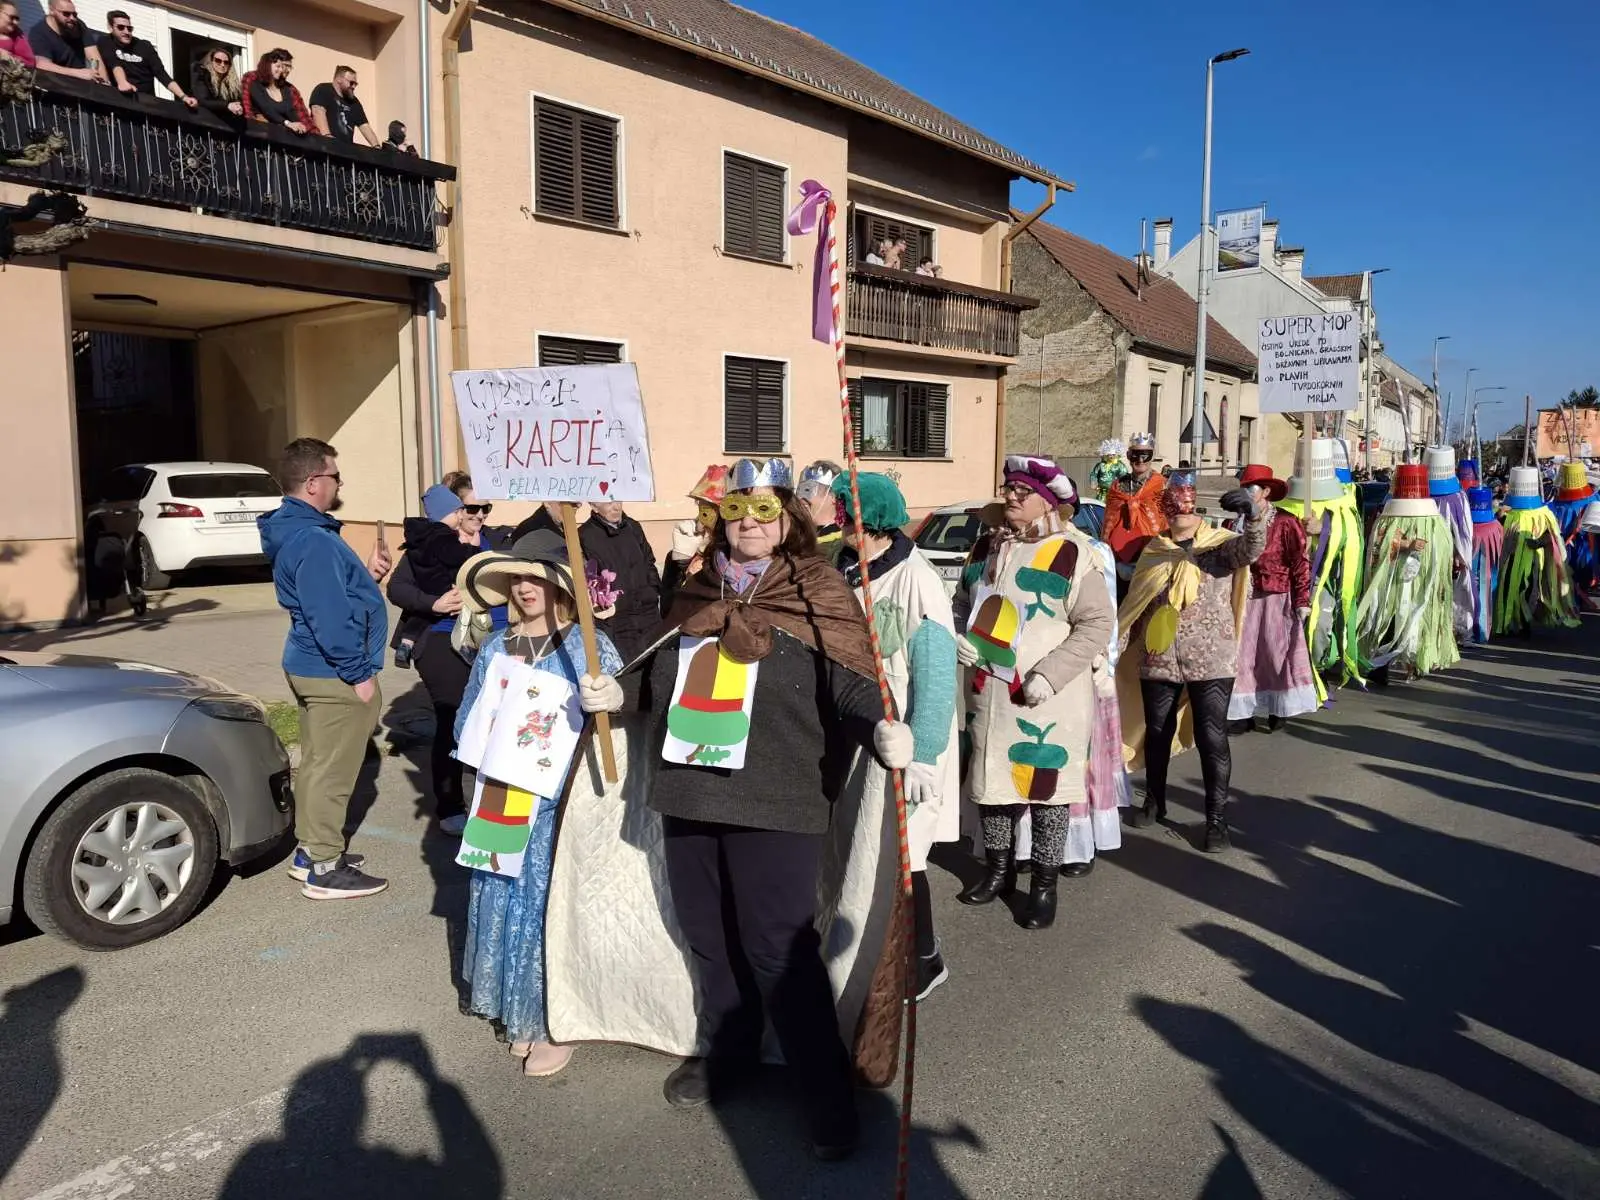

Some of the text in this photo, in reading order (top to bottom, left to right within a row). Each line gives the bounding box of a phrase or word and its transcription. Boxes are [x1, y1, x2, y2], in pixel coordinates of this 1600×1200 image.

[1261, 314, 1352, 337] SUPER MOP
[1320, 345, 1352, 353] GRADSKIM
[1314, 355, 1352, 366] UPRAVAMA
[1279, 371, 1308, 382] PLAVIH
[1292, 380, 1343, 391] TVRDOKORNIH
[1307, 393, 1337, 404] MRLJA
[508, 476, 597, 496] BELA PARTY
